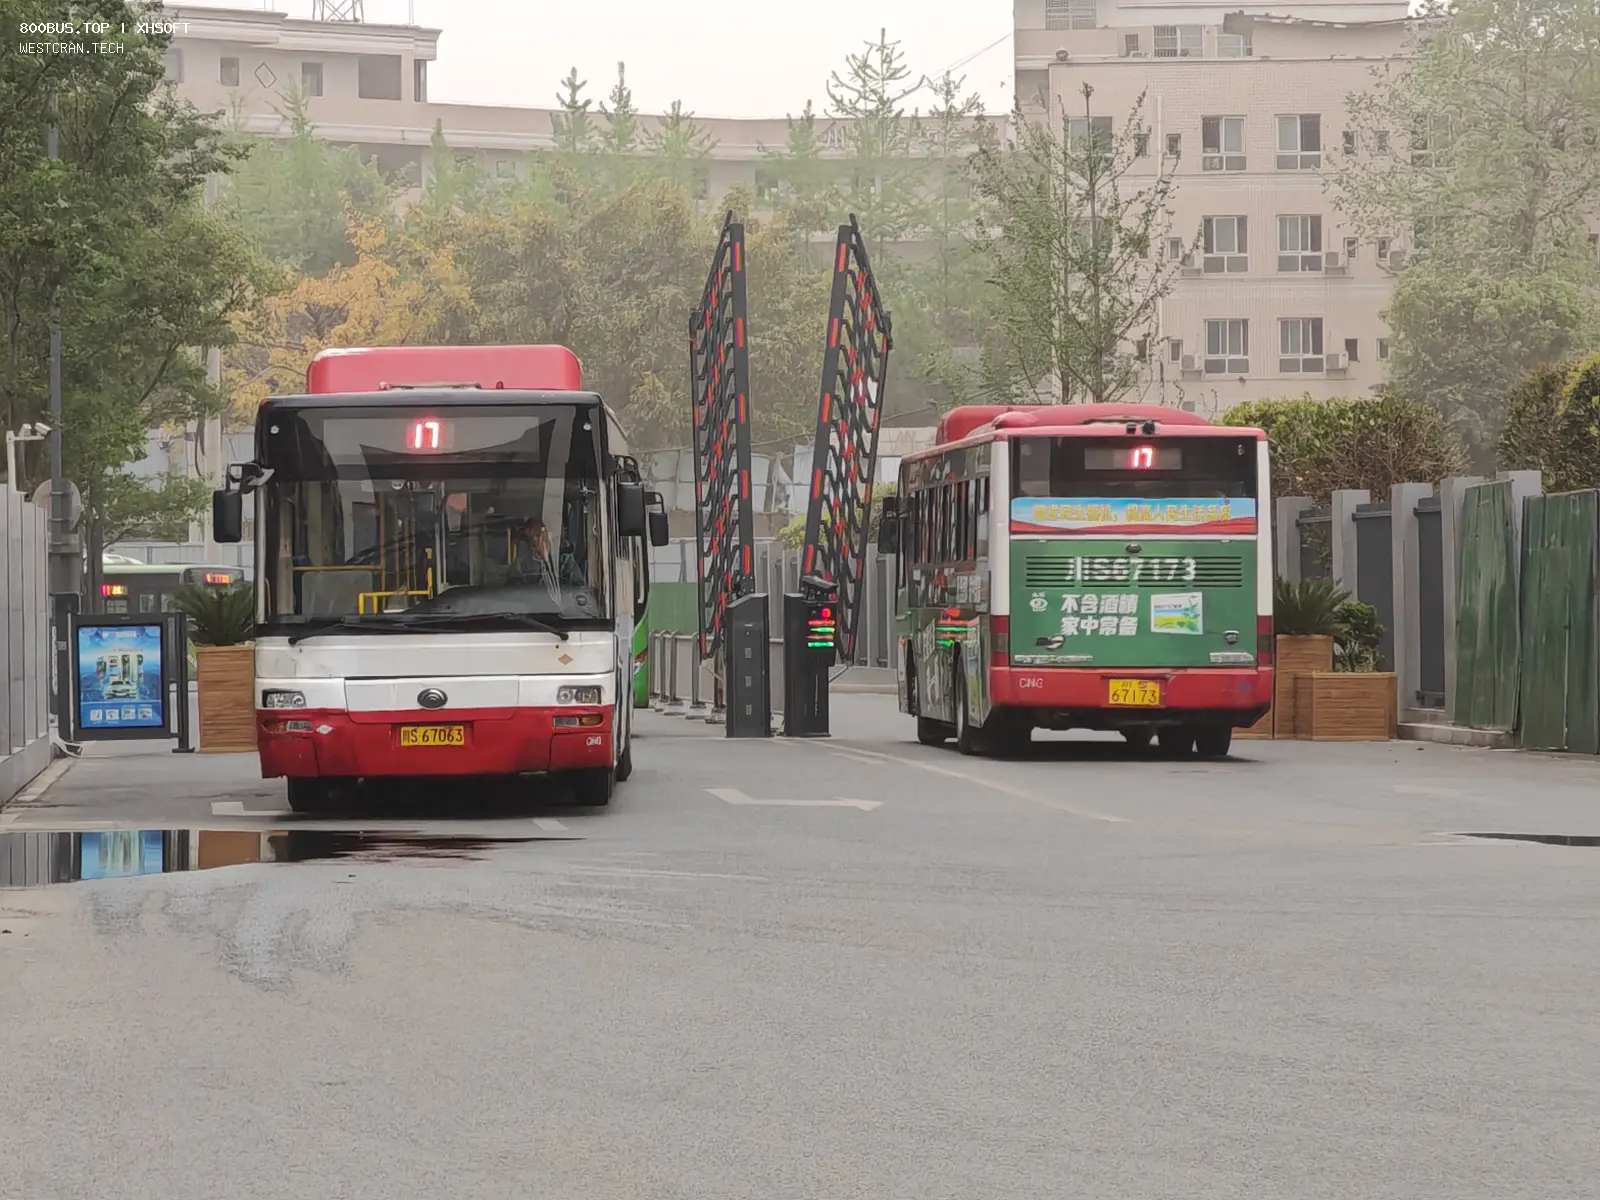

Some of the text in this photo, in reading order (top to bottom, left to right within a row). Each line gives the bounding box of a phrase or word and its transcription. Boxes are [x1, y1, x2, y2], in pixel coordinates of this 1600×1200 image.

[414, 421, 440, 449] 17
[1133, 447, 1154, 468] 17
[1060, 593, 1139, 614] 不含酒精
[1060, 615, 1139, 636] 家中常备
[1111, 689, 1157, 703] 67173
